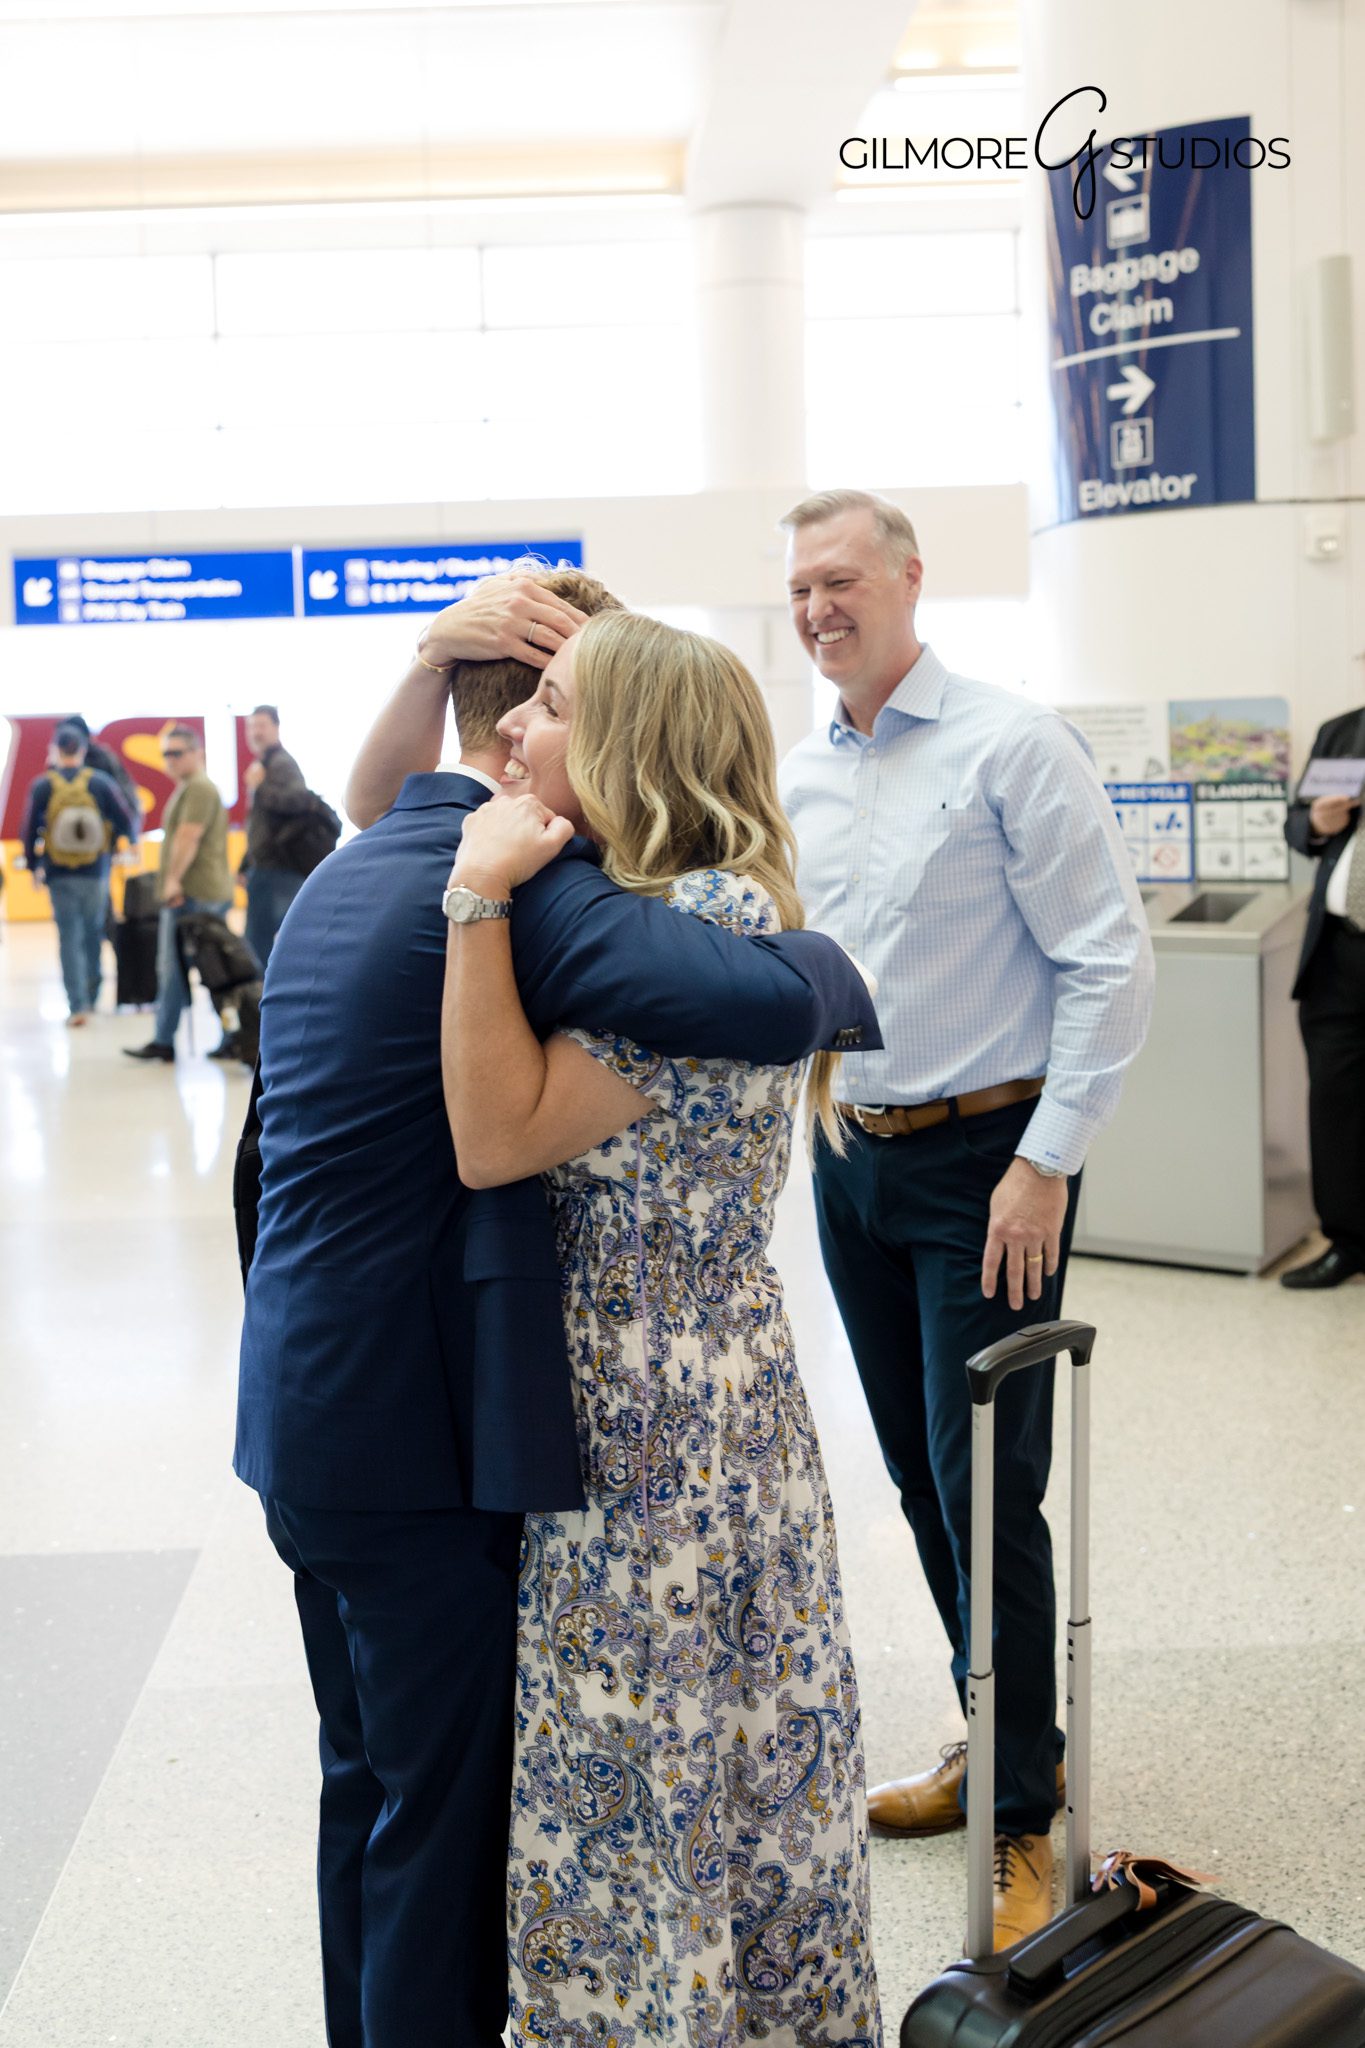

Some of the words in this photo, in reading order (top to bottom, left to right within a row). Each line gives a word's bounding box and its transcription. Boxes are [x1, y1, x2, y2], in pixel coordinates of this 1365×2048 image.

[1070, 247, 1200, 297] Baggage
[1089, 295, 1174, 336] Claim
[1078, 472, 1198, 512] Elevator
[1211, 783, 1286, 799] LANDFILL
